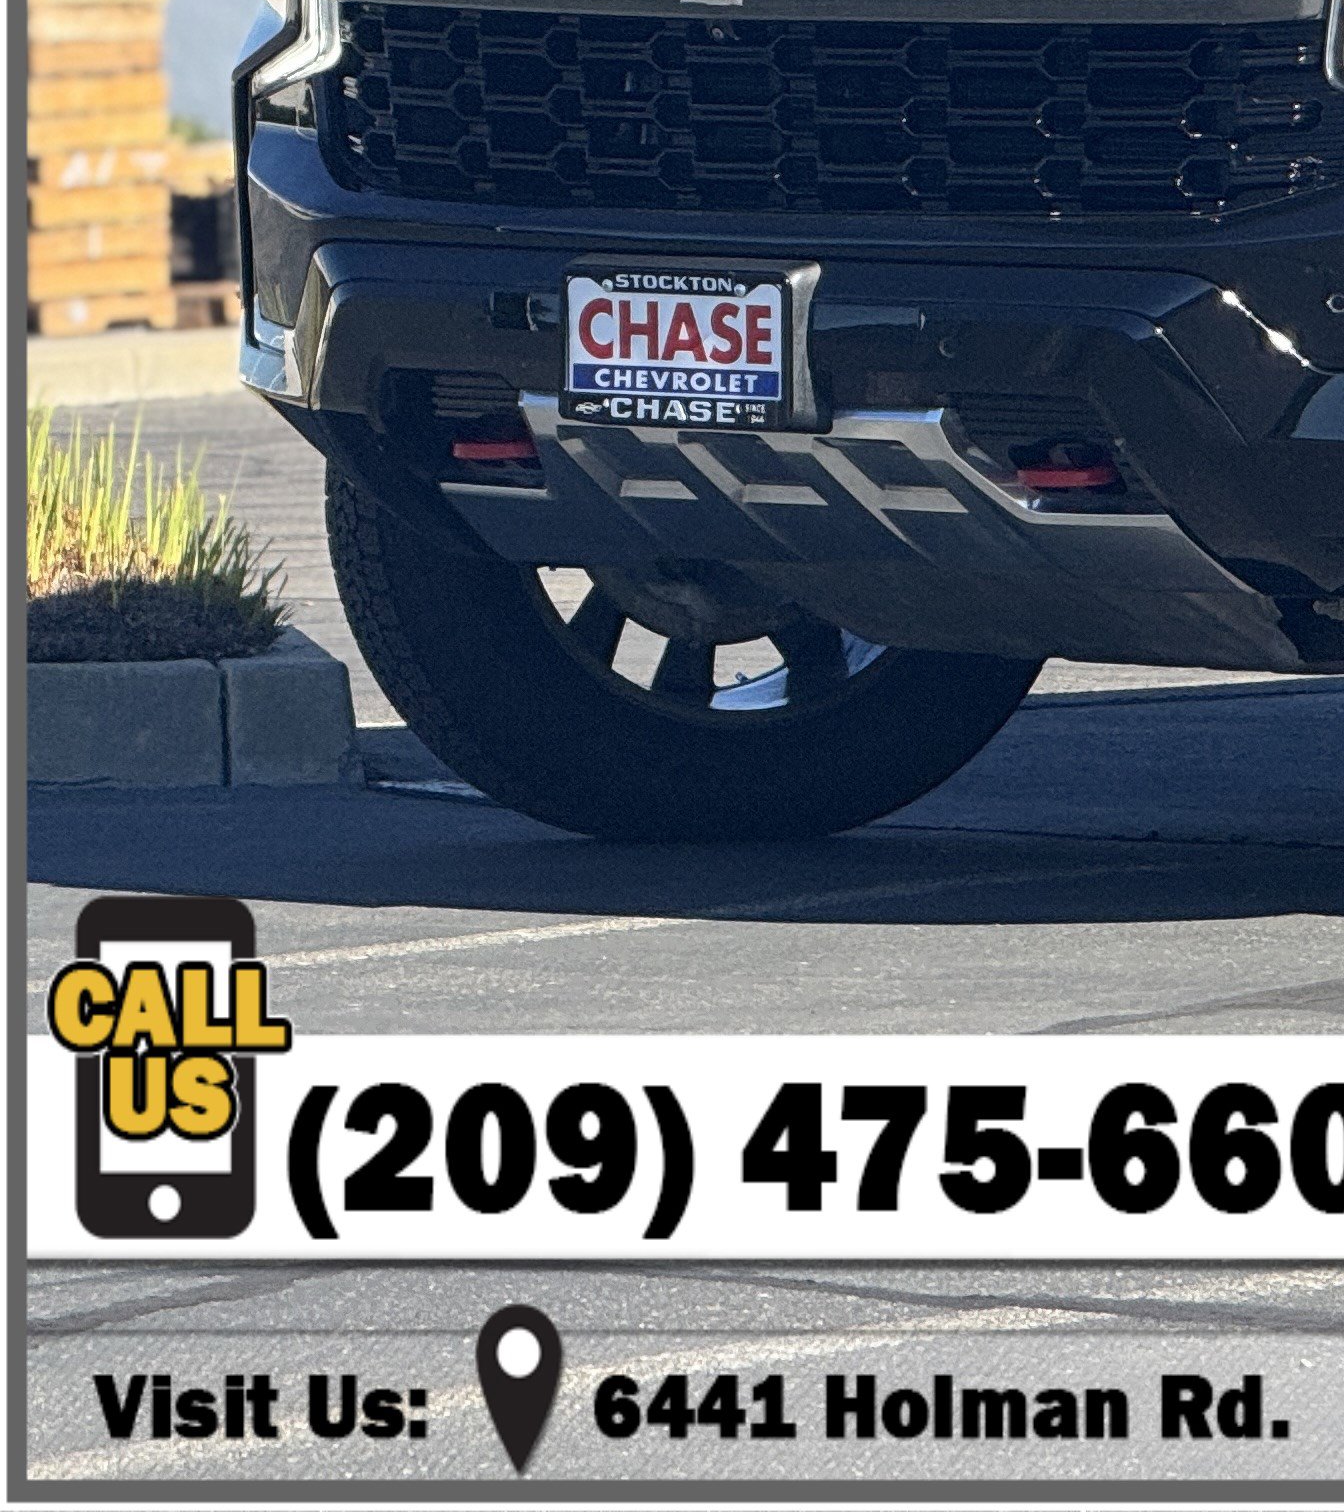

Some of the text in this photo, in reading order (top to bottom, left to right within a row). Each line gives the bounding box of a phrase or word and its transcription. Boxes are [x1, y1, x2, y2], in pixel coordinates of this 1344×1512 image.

[615, 273, 733, 293] STOCKTON
[578, 297, 773, 365] CHASE
[594, 368, 759, 393] CHEVROLET
[610, 397, 736, 424] CHASE
